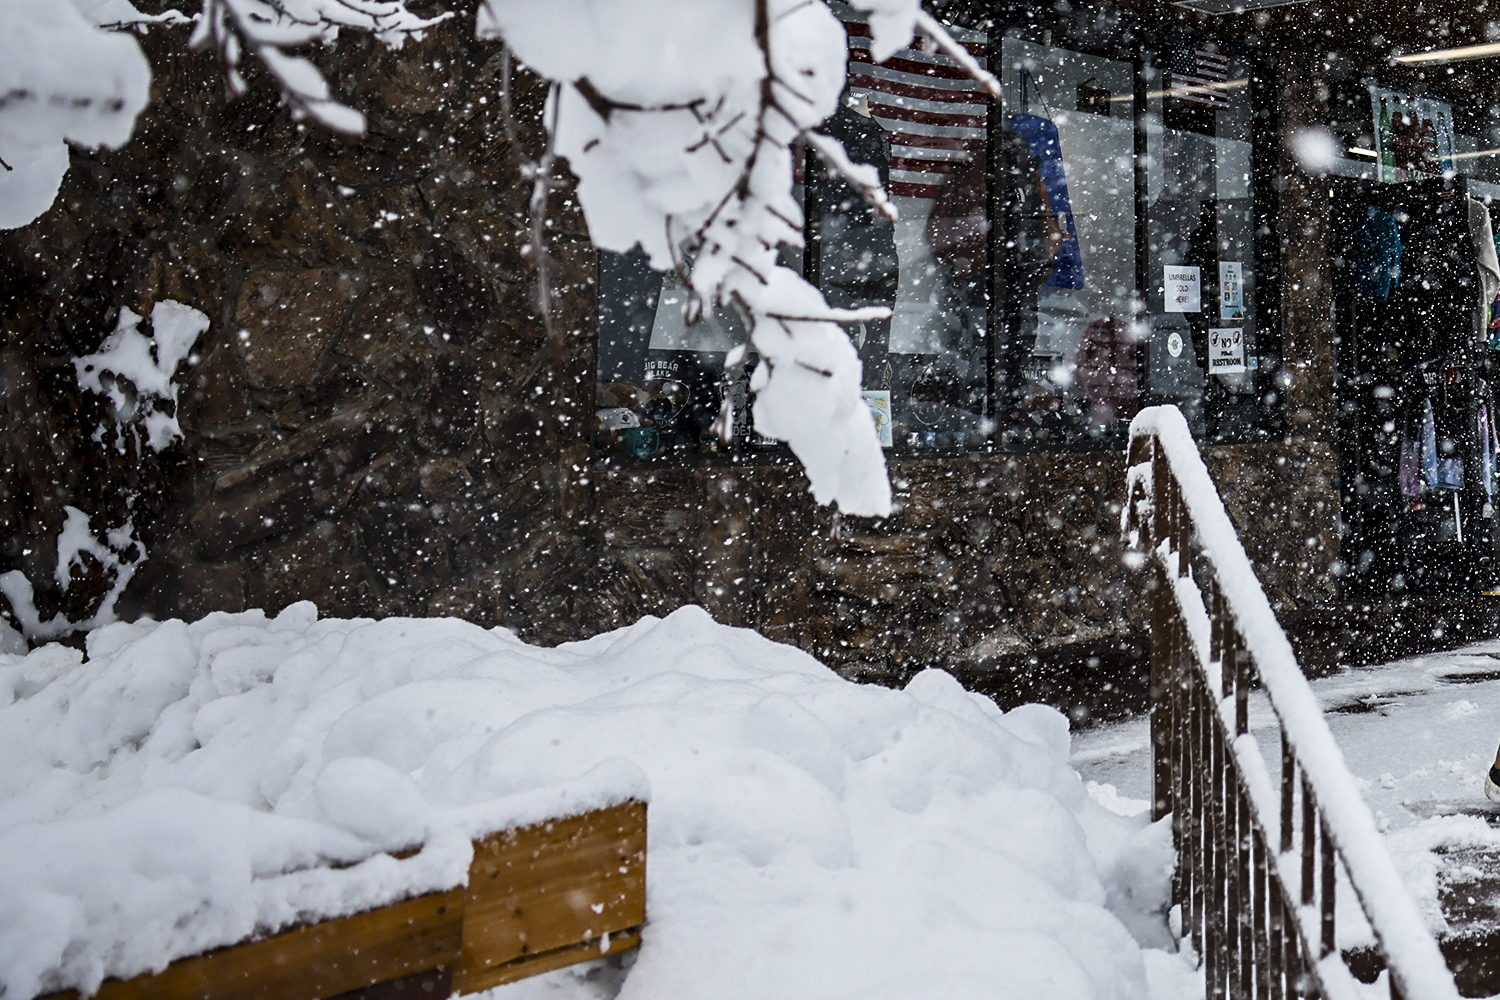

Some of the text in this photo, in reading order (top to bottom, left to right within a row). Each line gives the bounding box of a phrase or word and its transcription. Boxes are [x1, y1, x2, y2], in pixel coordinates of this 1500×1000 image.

[1168, 273, 1197, 282] UMBRELLAS
[1176, 284, 1189, 293] SOLD
[1221, 337, 1232, 349] NO
[657, 360, 679, 372] BEAR
[1212, 357, 1242, 367] RESTROOM
[649, 370, 671, 378] LAKE
